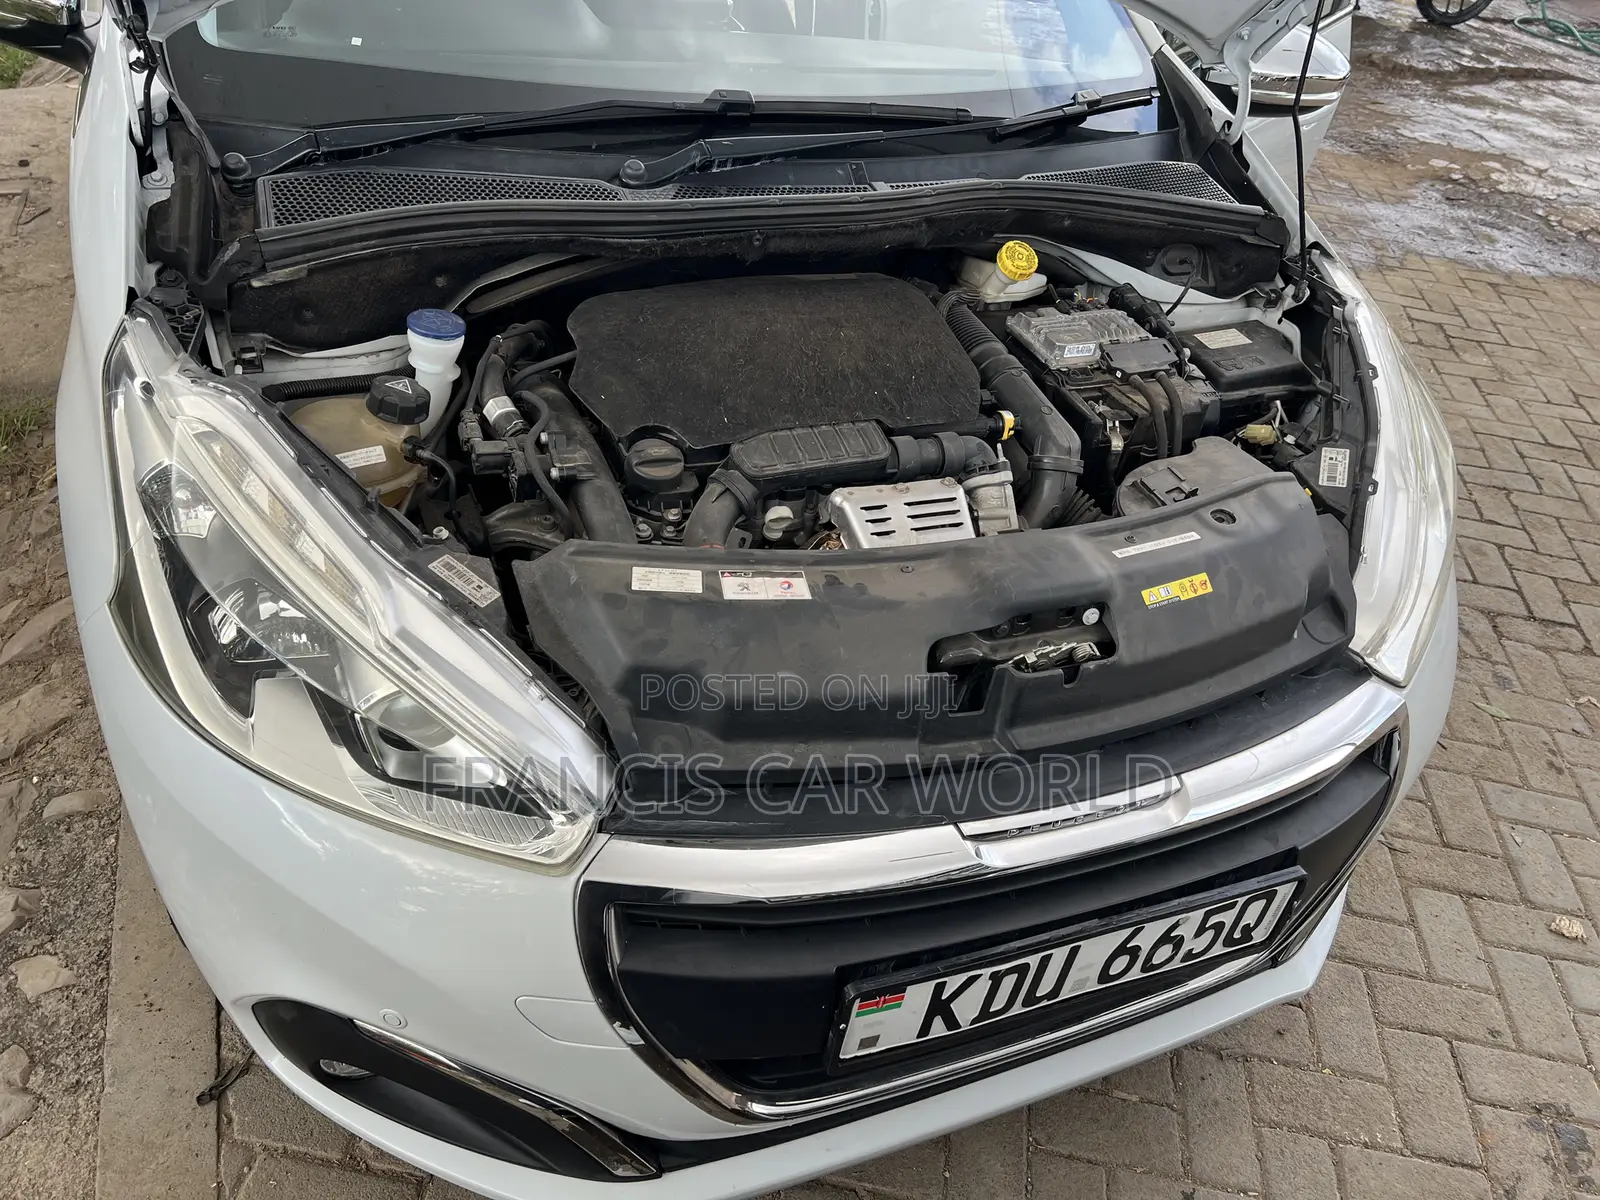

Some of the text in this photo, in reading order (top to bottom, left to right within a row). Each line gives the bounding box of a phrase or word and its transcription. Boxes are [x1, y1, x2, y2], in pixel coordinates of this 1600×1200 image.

[1006, 799, 1150, 838] PEUGEOT
[916, 888, 1279, 1039] KDU 665Q
